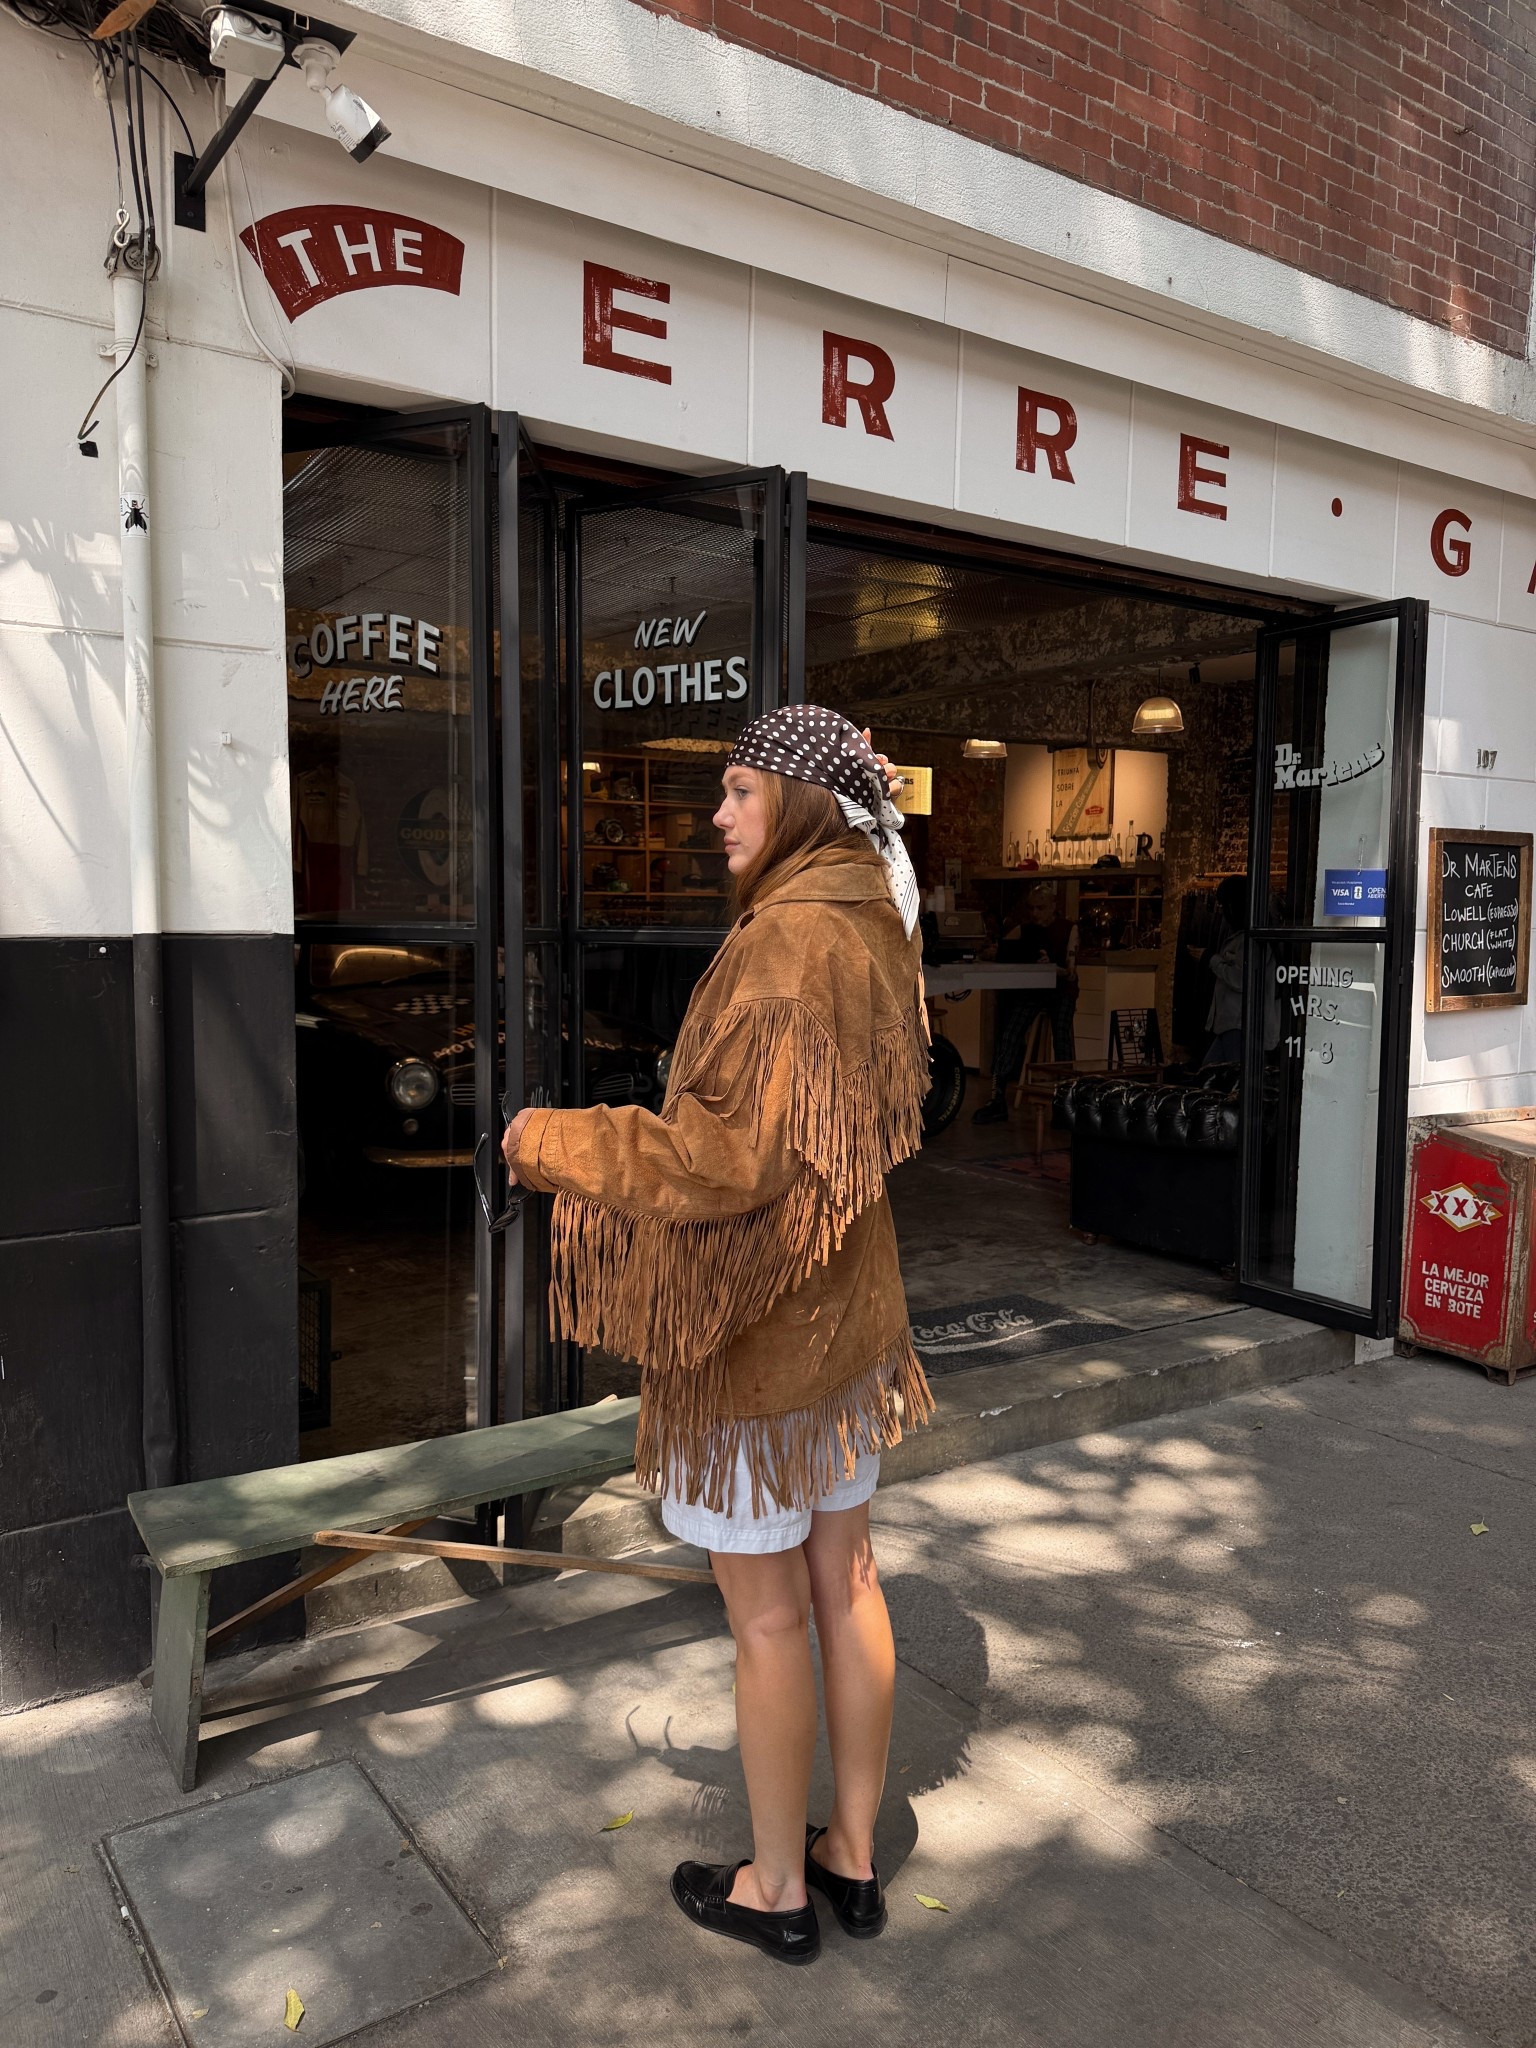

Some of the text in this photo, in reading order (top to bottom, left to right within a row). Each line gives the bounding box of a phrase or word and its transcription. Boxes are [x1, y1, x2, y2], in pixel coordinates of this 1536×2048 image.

[277, 224, 424, 289] THE
[583, 260, 1230, 522] ERRE
[634, 610, 707, 649] NEW
[287, 613, 440, 677] COFFEE
[319, 675, 404, 715] HERE
[593, 655, 749, 709] CLOTHES
[1274, 742, 1385, 790] Martens
[1056, 782, 1075, 792] SOBRE
[1465, 851, 1517, 879] MARTENS
[1331, 888, 1350, 897] VISA
[1465, 882, 1494, 899] CAFE
[1444, 902, 1487, 922] LOWELL
[1442, 929, 1485, 953] CHURCH
[1276, 965, 1354, 988] OPENING
[1442, 965, 1485, 988] SMOOTH
[1284, 1036, 1302, 1058] 11
[1320, 1041, 1334, 1064] 8
[1430, 1191, 1491, 1225] XXX
[1422, 1260, 1490, 1289] LA MEJOR
[1424, 1277, 1484, 1304] CERVEZA
[1424, 1292, 1482, 1319] EN BOTE
